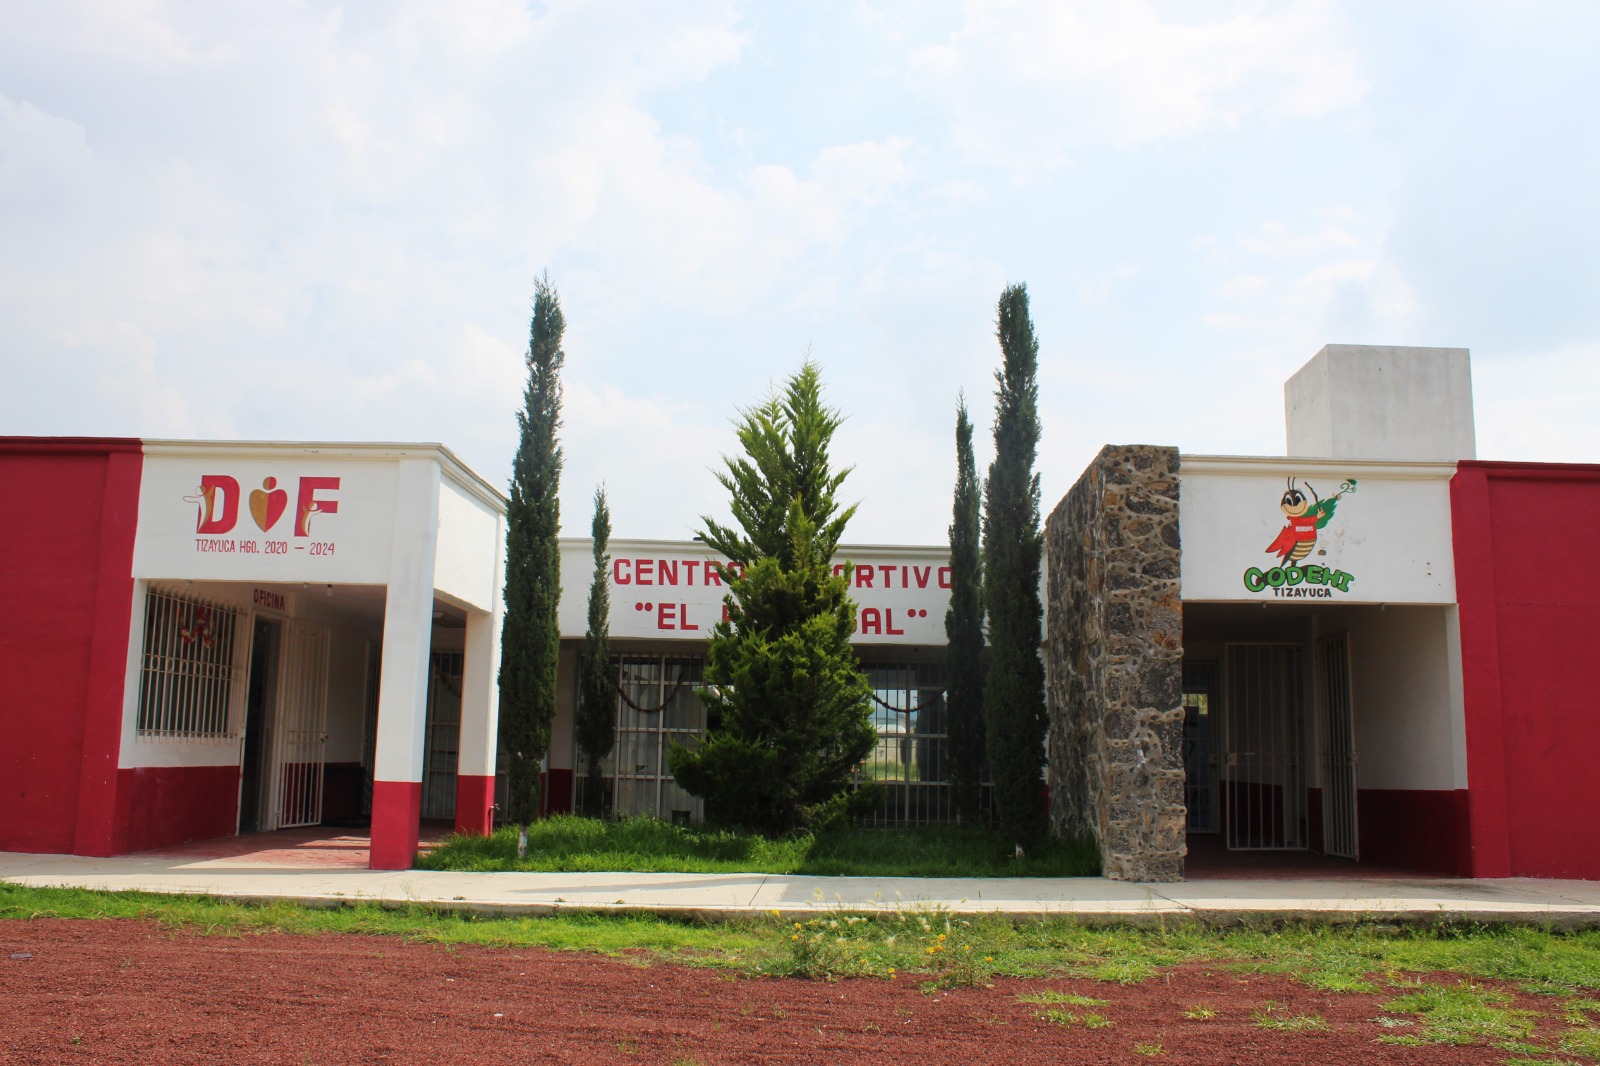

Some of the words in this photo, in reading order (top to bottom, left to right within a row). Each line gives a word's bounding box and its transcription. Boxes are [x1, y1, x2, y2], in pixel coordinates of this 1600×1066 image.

[195, 538, 235, 554] TIZAYUCA
[239, 540, 260, 555] HGO.
[264, 541, 288, 555] 2020
[309, 542, 335, 556] 2024
[1243, 564, 1355, 593] CODEHI
[253, 588, 285, 611] OFICINA
[1272, 587, 1332, 598] TIZAYUCA
